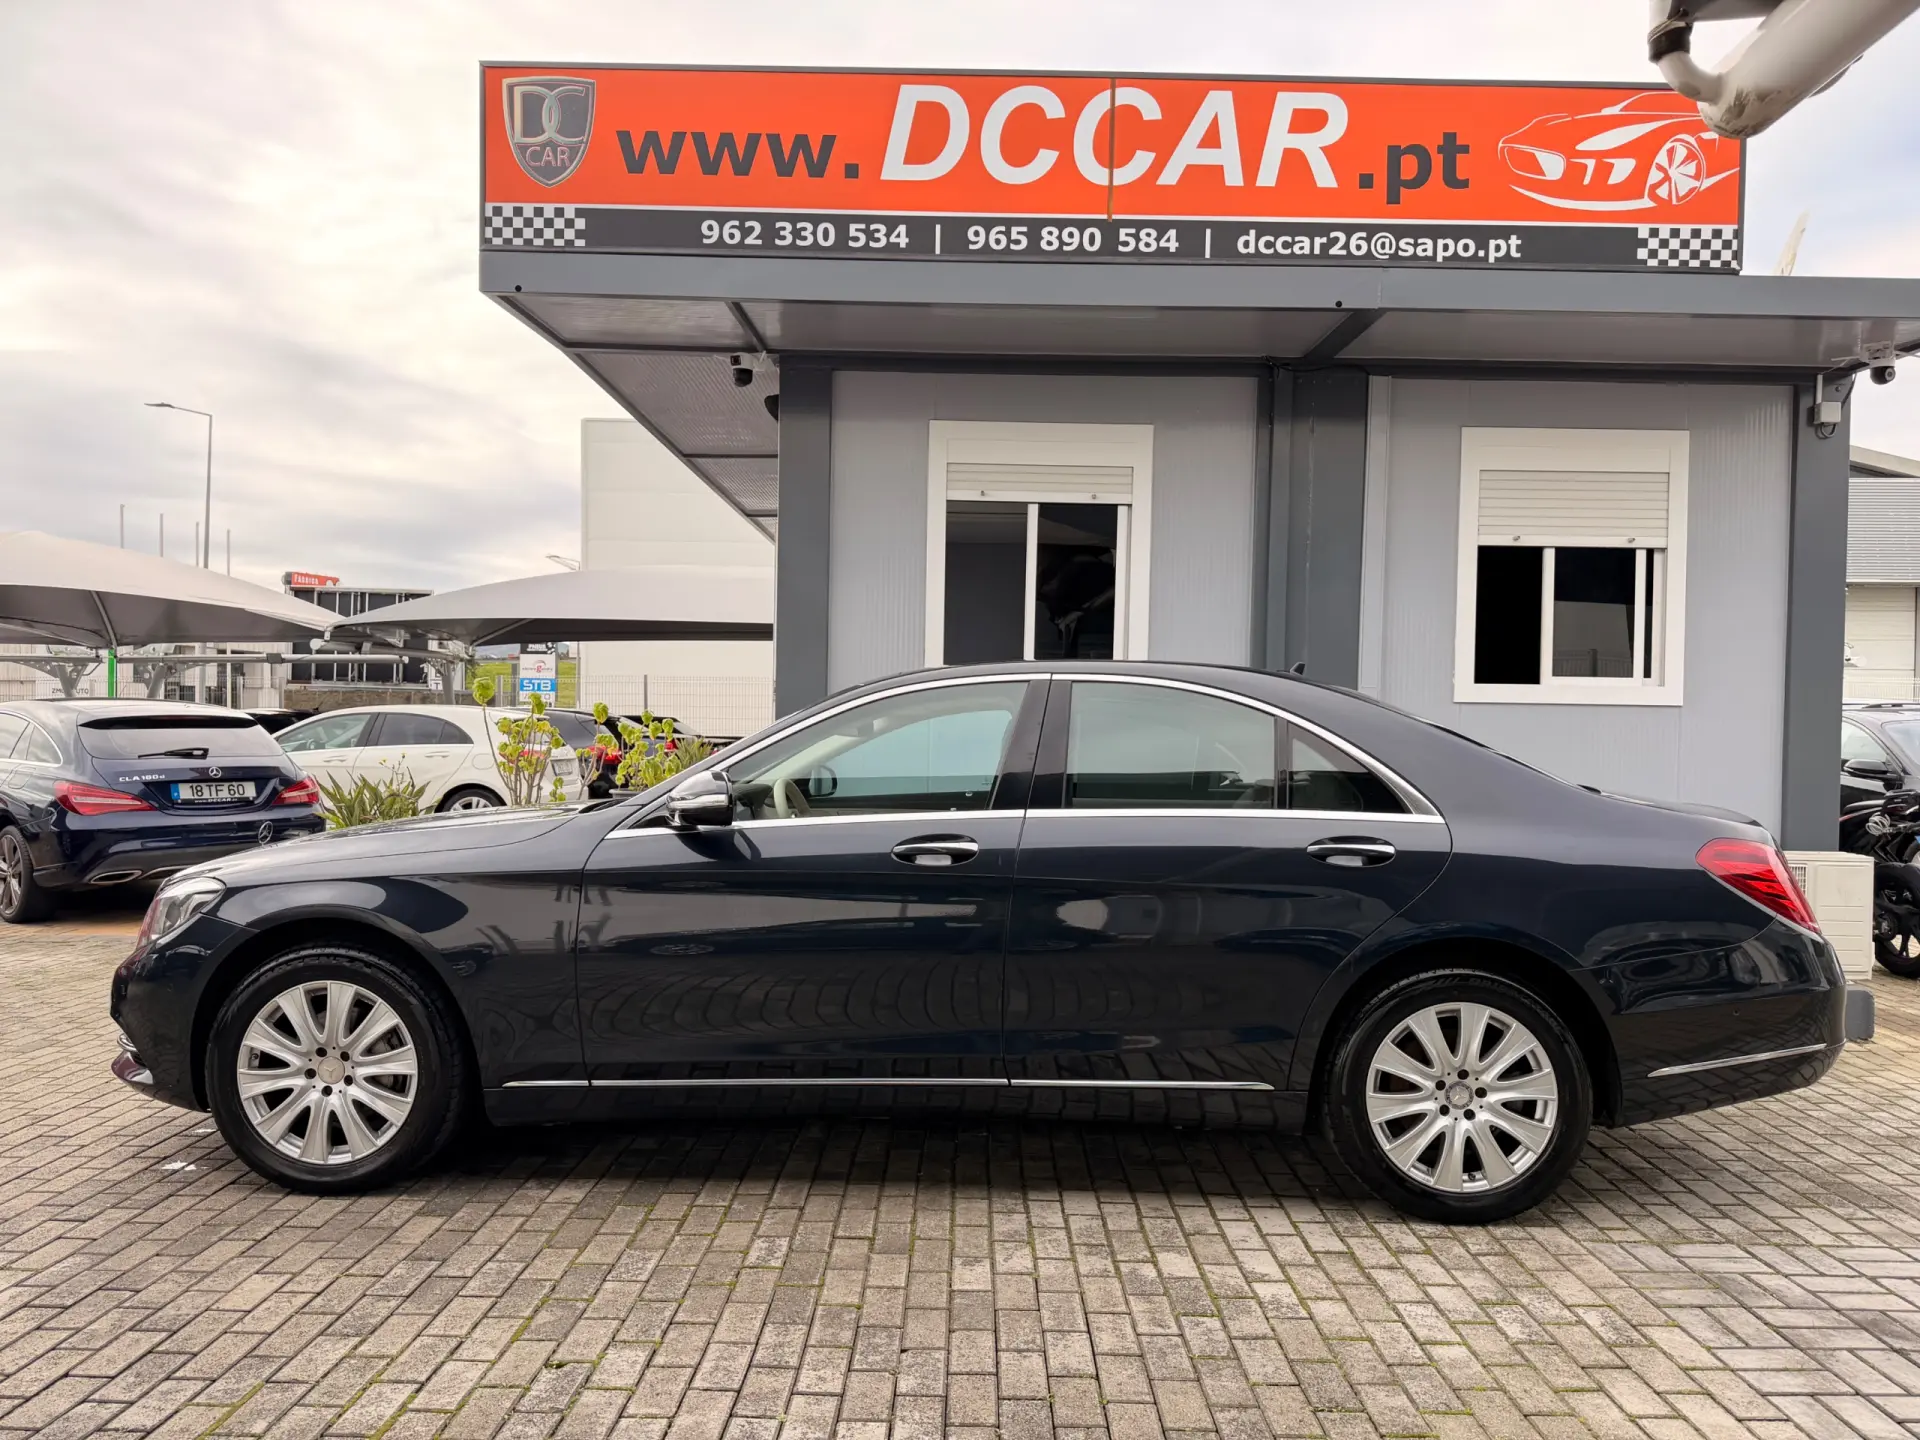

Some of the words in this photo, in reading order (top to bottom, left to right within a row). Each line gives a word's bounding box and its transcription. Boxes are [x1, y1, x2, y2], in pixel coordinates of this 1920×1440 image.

[526, 146, 571, 167] CAR
[701, 219, 763, 246] 962
[775, 221, 836, 248] 330
[848, 223, 910, 250] 534
[967, 225, 1028, 252] 965
[1041, 226, 1102, 253] 890
[1117, 227, 1180, 254] 584
[1237, 229, 1522, 264] dccar26@sapo.pt
[523, 680, 551, 690] STB
